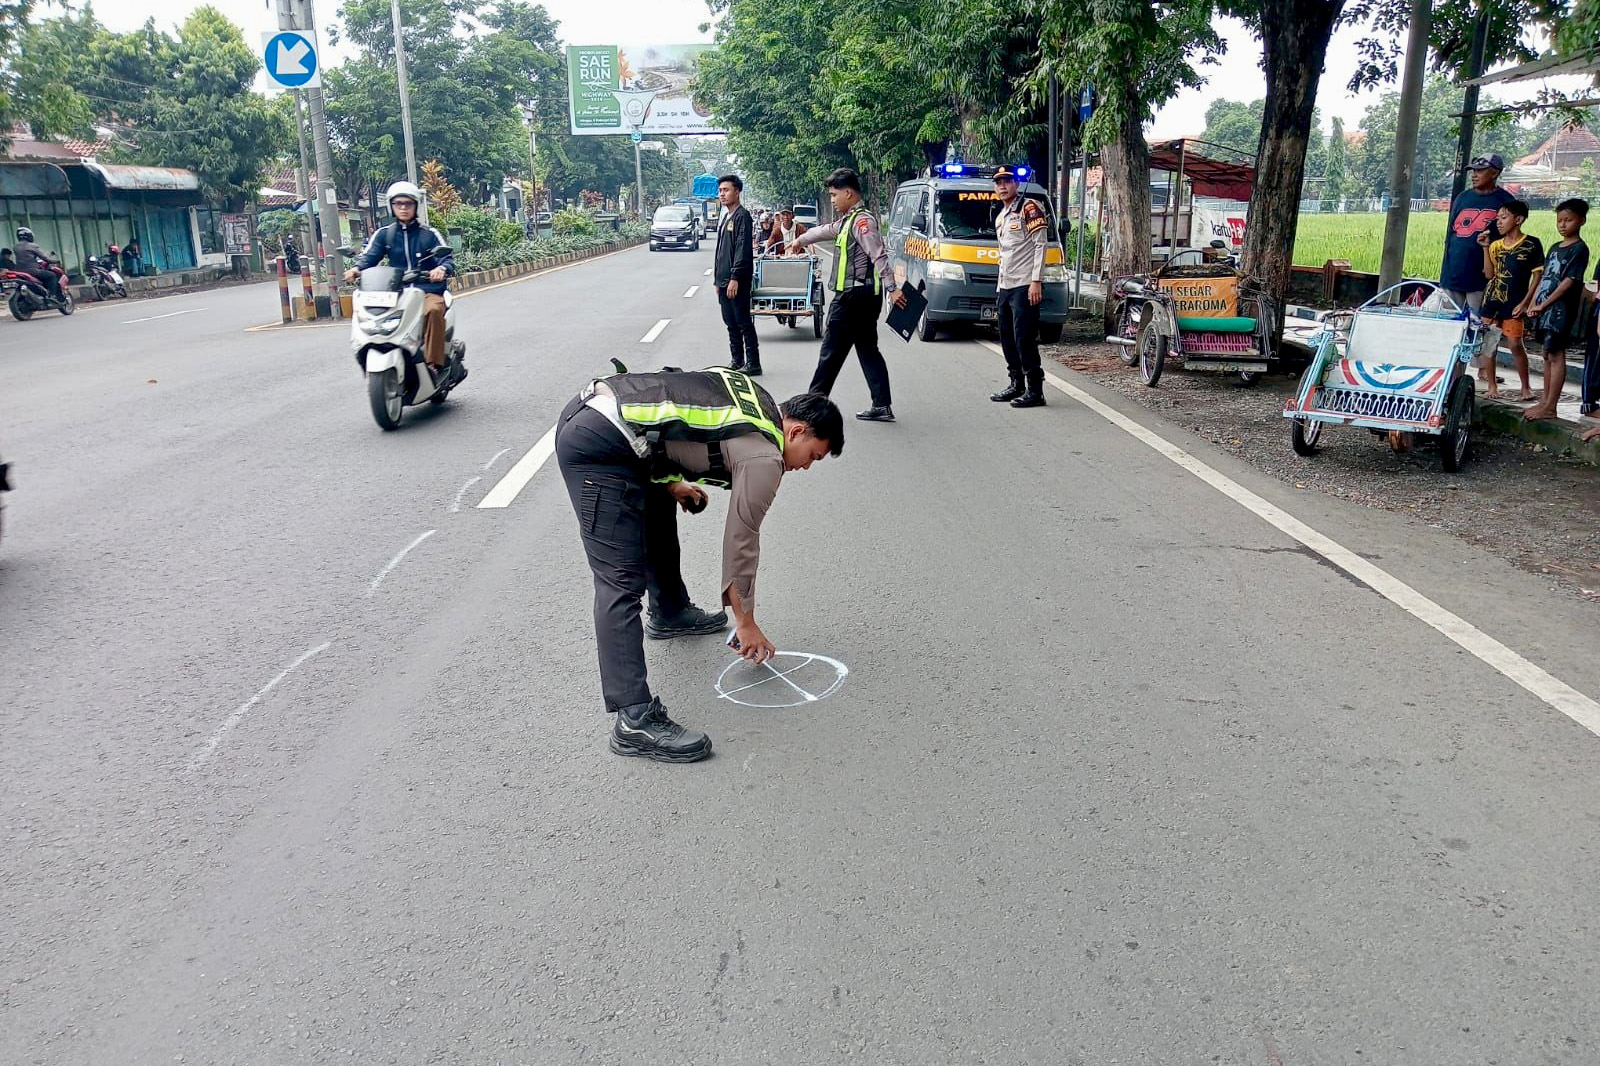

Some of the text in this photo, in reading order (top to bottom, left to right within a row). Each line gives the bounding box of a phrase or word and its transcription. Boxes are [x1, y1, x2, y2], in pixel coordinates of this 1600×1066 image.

[579, 55, 611, 68] SAE
[580, 68, 611, 80] RUN
[959, 192, 1001, 201] PAMA
[976, 249, 1000, 259] PO
[1176, 285, 1212, 297] SEGAR
[1173, 299, 1227, 311] ERAROMA
